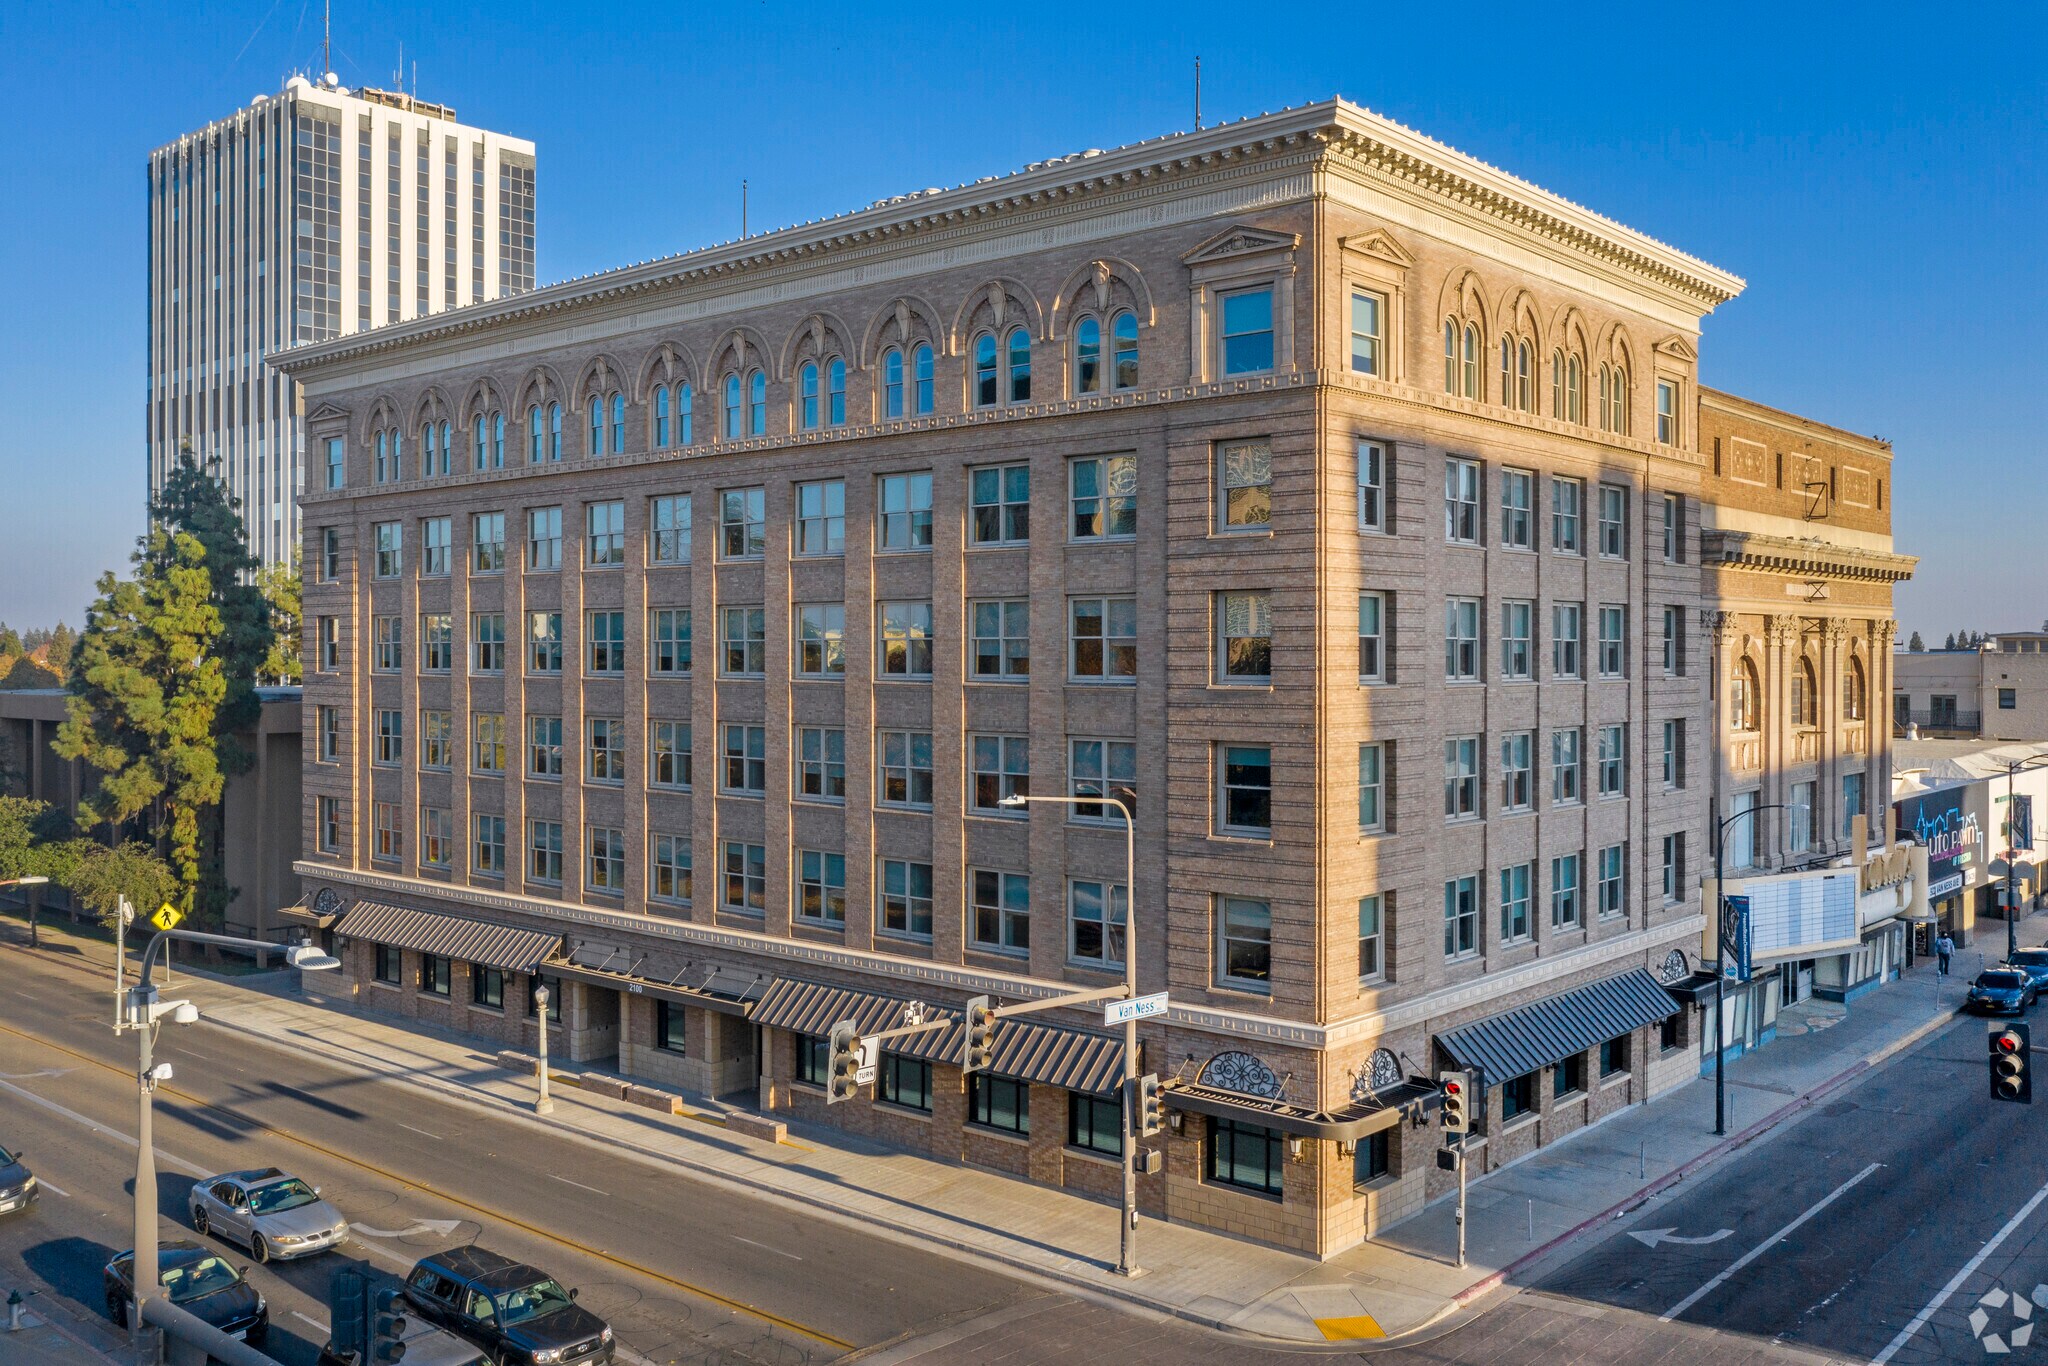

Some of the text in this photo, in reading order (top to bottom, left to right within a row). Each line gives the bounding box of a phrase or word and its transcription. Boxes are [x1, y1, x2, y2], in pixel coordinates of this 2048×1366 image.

[630, 984, 642, 993] 2100
[1119, 1002, 1154, 1018] Van Ness
[859, 1071, 874, 1079] TURN
